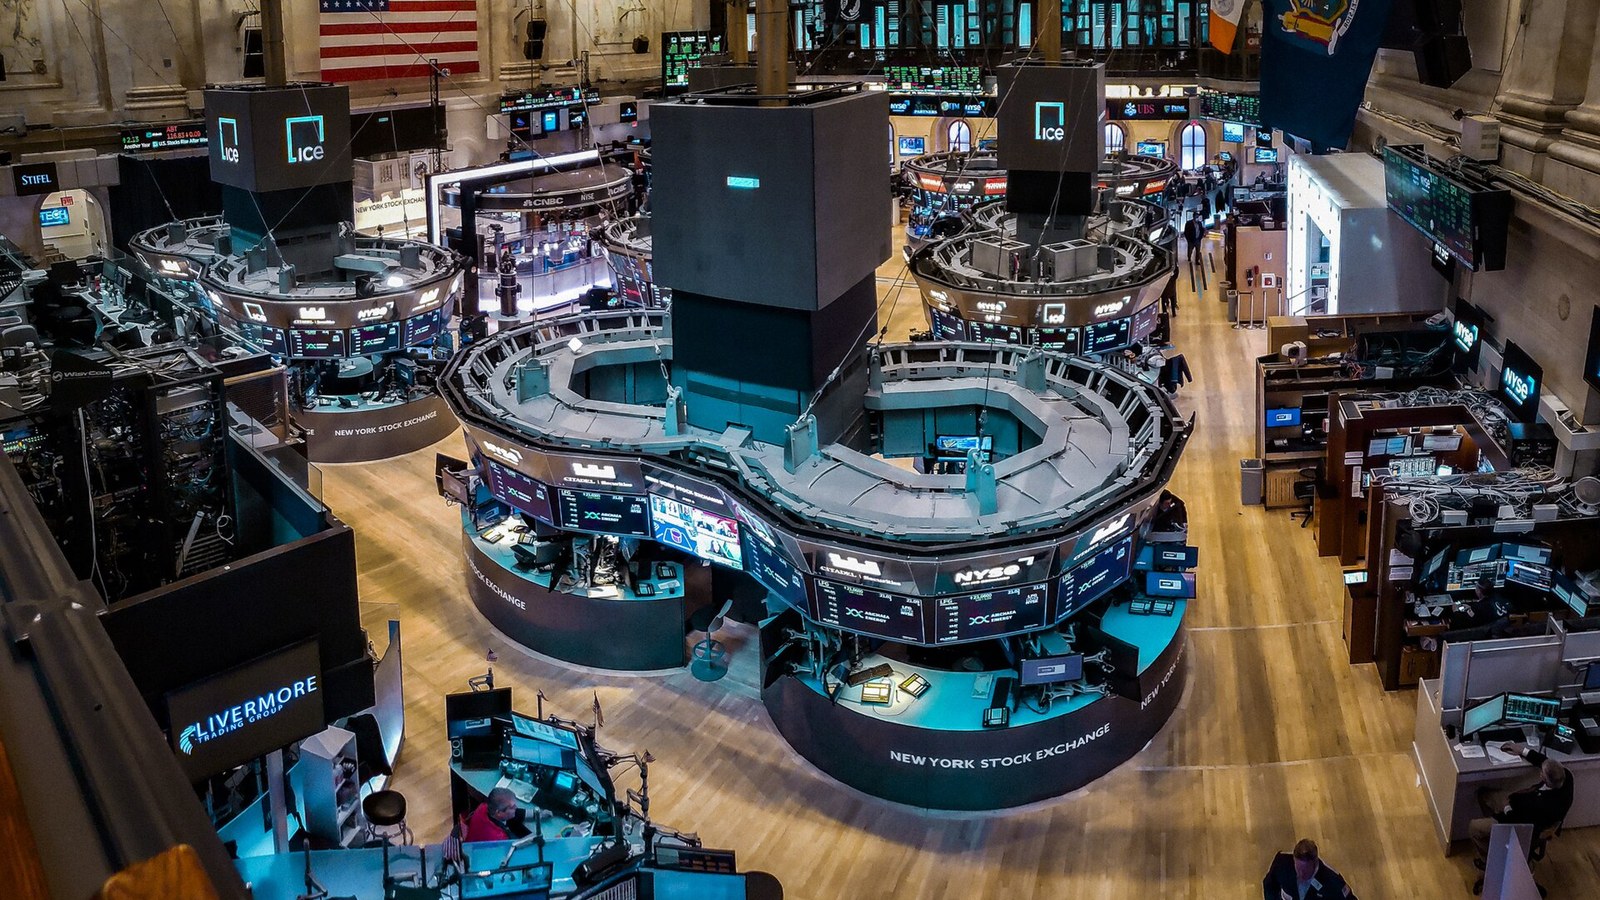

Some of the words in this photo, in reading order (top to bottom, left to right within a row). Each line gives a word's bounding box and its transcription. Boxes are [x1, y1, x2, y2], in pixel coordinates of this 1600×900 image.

[1138, 104, 1155, 114] UBS
[21, 173, 51, 186] STIFEL
[355, 206, 369, 214] NEW
[369, 203, 384, 211] YORK
[384, 200, 402, 208] STOCK
[533, 198, 564, 206] CNBC
[355, 427, 376, 435] YORK
[378, 422, 402, 433] STOCK
[403, 410, 437, 427] EXCHANGE
[485, 577, 527, 611] EXCHANGE
[196, 675, 318, 738] LIVERMORE
[1141, 684, 1159, 710] NEW
[197, 721, 245, 744] TRADING
[249, 704, 283, 723] GROUP
[890, 750, 927, 766] NEW
[929, 757, 975, 769] YORK
[980, 753, 1032, 769] STOCK
[1035, 722, 1111, 761] EXCHANGE
